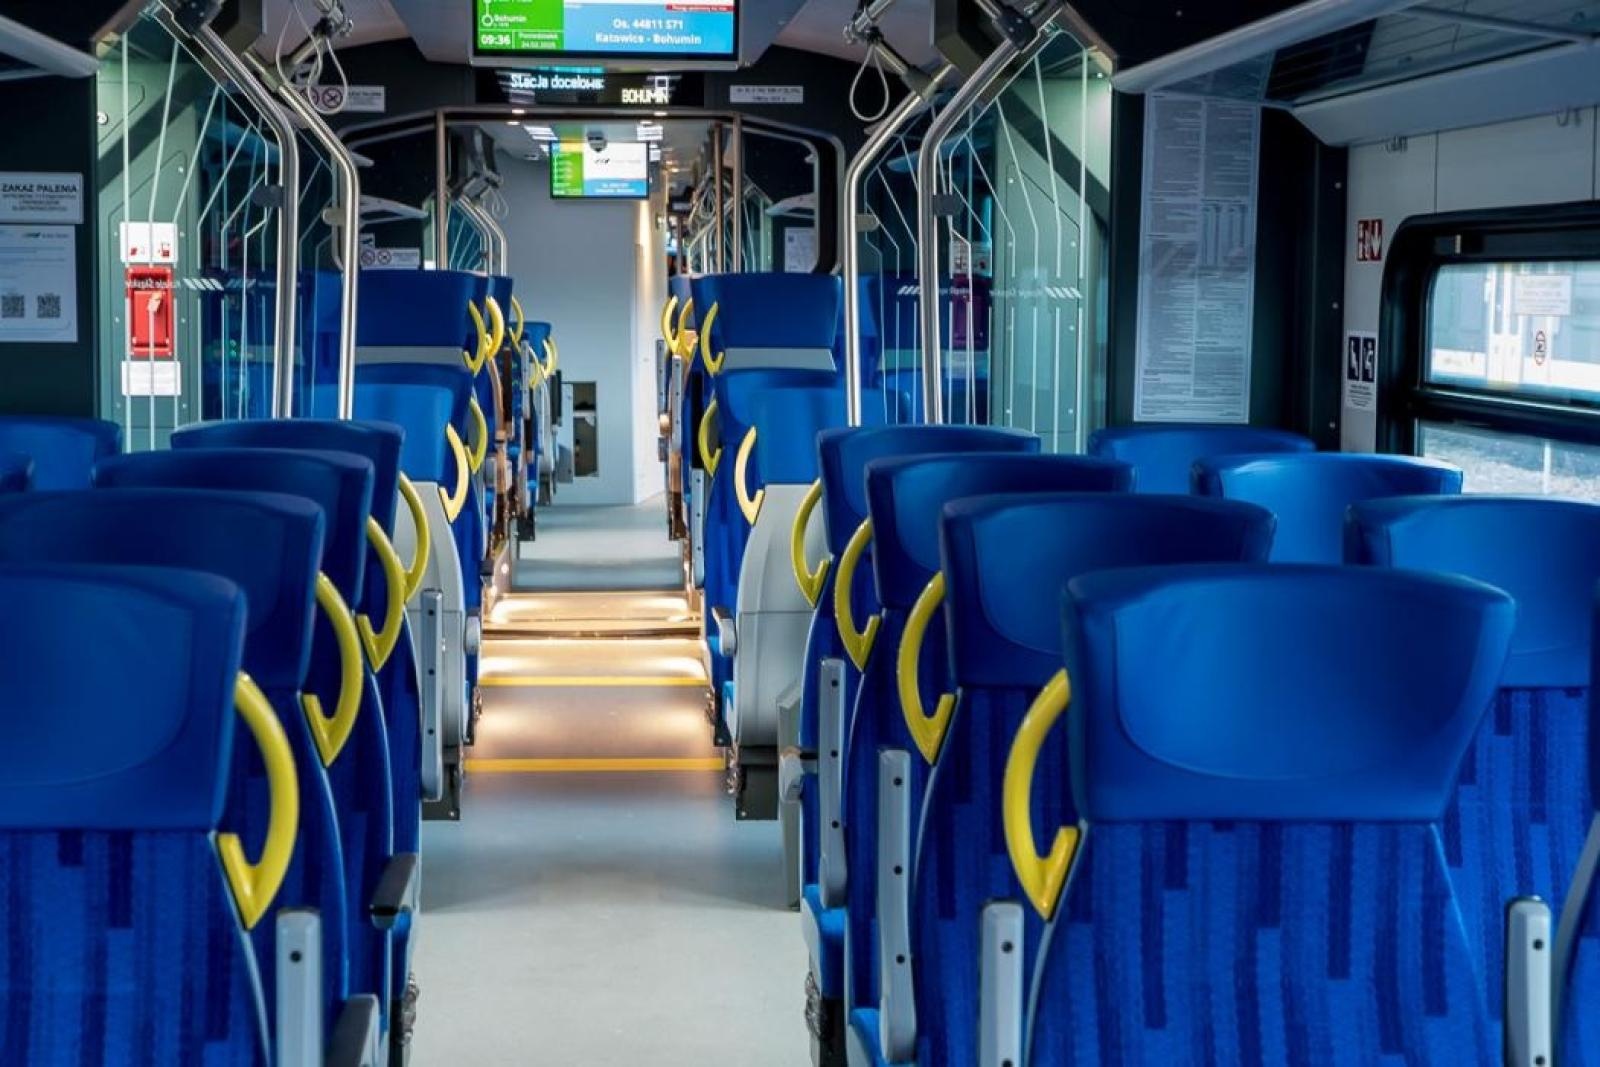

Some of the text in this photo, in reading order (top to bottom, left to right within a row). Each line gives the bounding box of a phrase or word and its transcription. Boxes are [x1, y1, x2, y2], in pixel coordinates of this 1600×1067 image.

[481, 34, 512, 46] 09:36
[595, 31, 645, 44] Katowice
[653, 32, 702, 45] Bohumin
[511, 74, 549, 88] Stacja
[2, 183, 77, 193] ZAKAZ PALENIA
